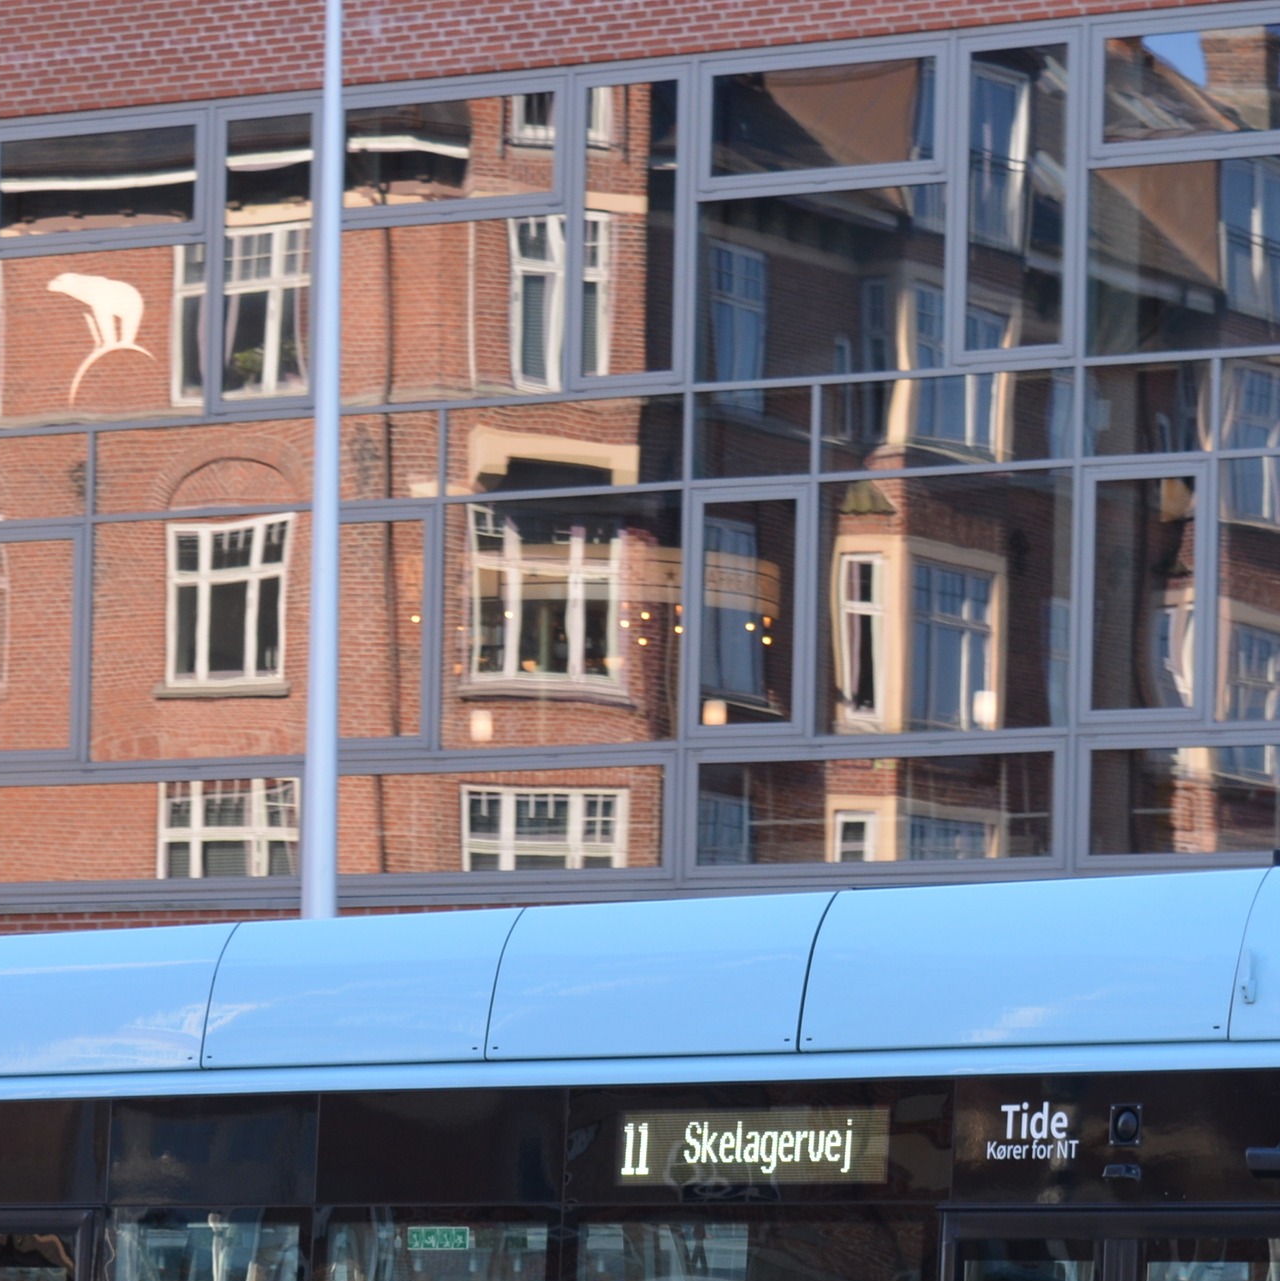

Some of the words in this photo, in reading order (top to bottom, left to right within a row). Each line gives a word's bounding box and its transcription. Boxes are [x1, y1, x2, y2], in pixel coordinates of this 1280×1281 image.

[1001, 1101, 1069, 1140] Tide
[620, 1122, 649, 1175] 11
[683, 1118, 853, 1174] Skelagervej
[986, 1141, 1030, 1160] Kører
[1031, 1140, 1055, 1159] for
[1056, 1139, 1080, 1158] NT
